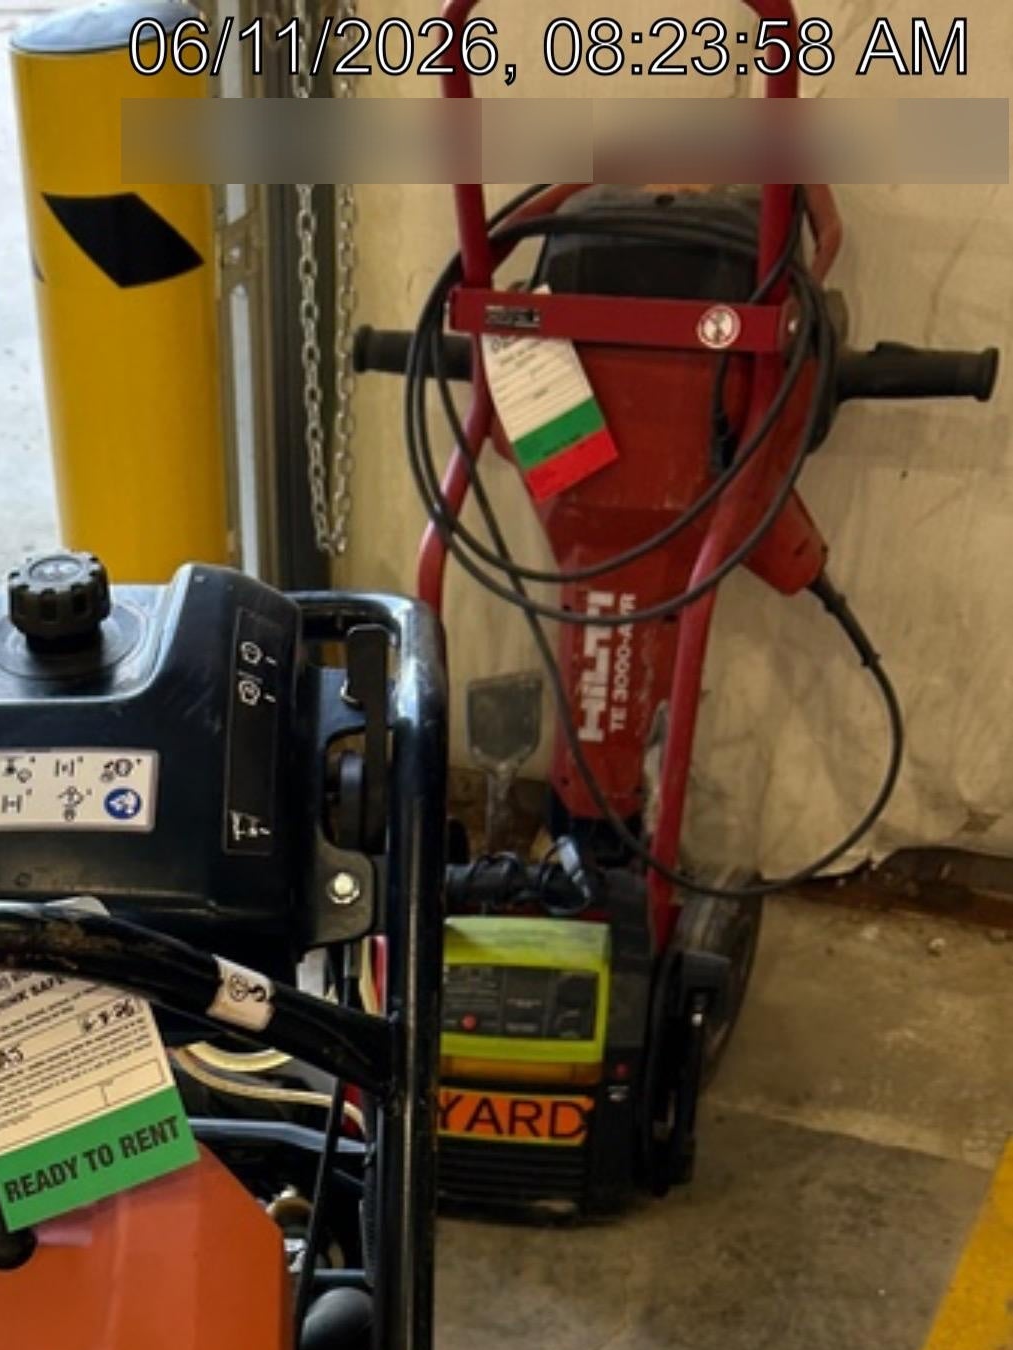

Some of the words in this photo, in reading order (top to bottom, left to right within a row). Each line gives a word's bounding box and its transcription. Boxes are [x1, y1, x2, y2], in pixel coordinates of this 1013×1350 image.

[578, 591, 615, 742] HILTI
[609, 706, 628, 733] TE
[439, 1093, 588, 1140] YARD
[3, 1154, 79, 1204] READY
[83, 1143, 115, 1172] TO
[118, 1115, 180, 1159] RENT
